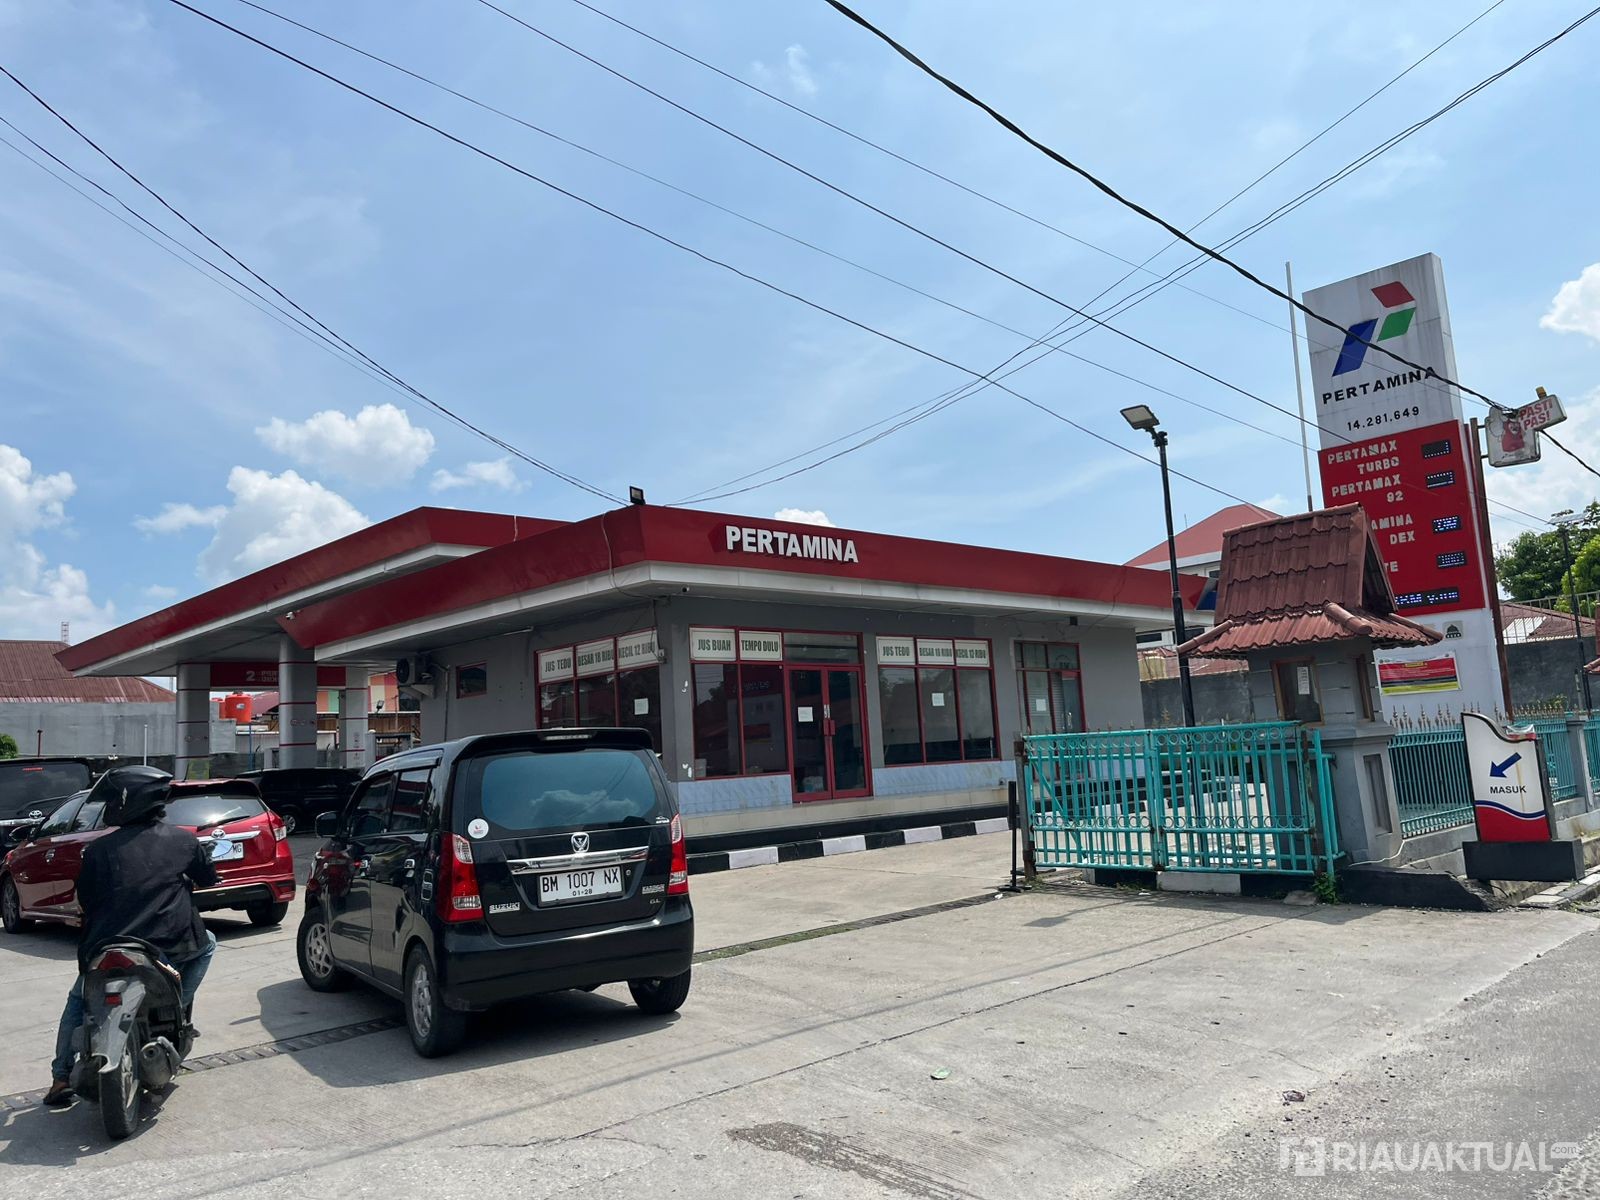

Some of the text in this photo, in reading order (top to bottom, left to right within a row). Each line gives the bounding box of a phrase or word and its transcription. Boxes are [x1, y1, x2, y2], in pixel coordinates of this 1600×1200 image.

[1322, 366, 1437, 405] PERTAMINA
[1347, 406, 1420, 431] 14.281.649
[1519, 400, 1553, 420] PASTI
[1327, 440, 1397, 465] PERTAMAX
[1357, 456, 1400, 475] TURBO
[1331, 474, 1401, 497] PERTAMAX
[1386, 490, 1404, 503] 92
[726, 525, 859, 563] PERTAMINA
[1390, 530, 1416, 545] DEX
[698, 639, 731, 651] JUS BUAH
[741, 640, 779, 652] TEMPO DULU
[882, 646, 893, 656] JUS
[545, 658, 555, 673] JUS
[1490, 785, 1527, 794] MASUK
[542, 868, 619, 893] BM 1007 NX
